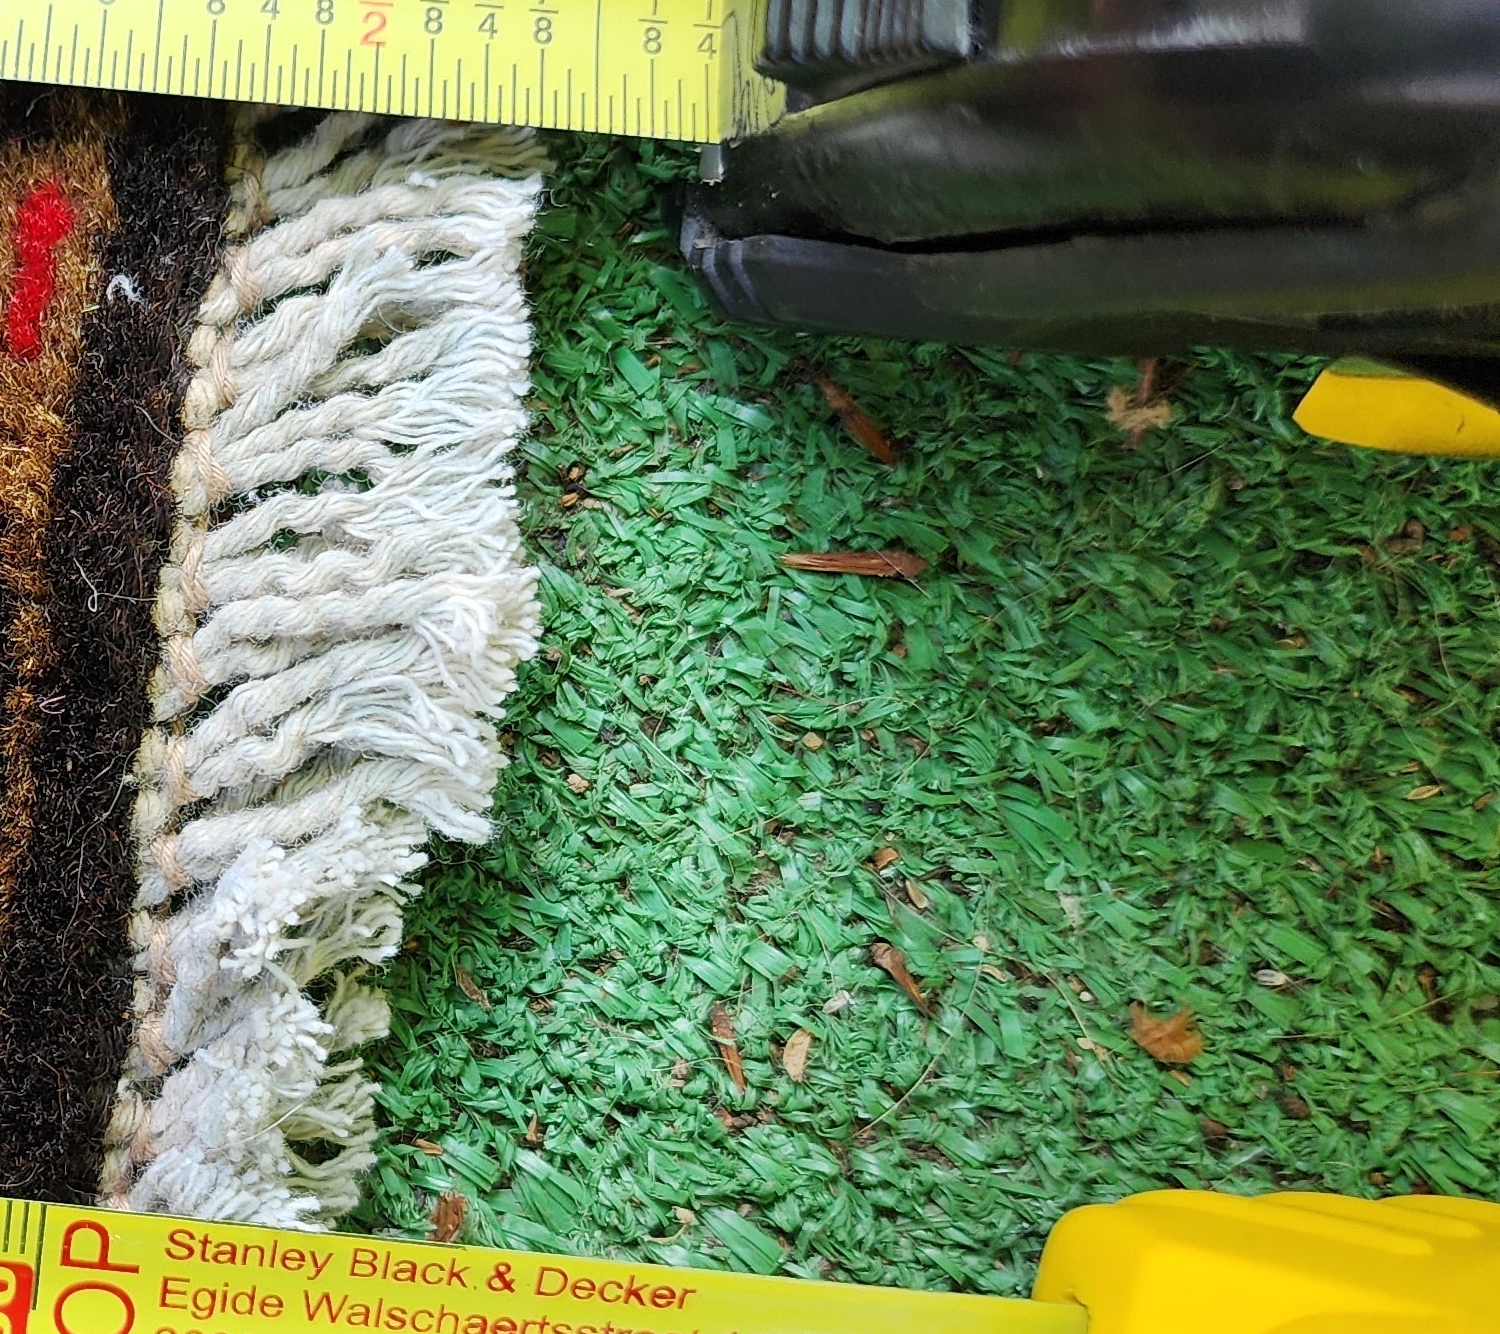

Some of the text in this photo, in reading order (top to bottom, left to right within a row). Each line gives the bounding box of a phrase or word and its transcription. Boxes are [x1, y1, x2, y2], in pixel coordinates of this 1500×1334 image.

[159, 1276, 284, 1320] Egide
[164, 1228, 697, 1310] Stanley Black & Decker
